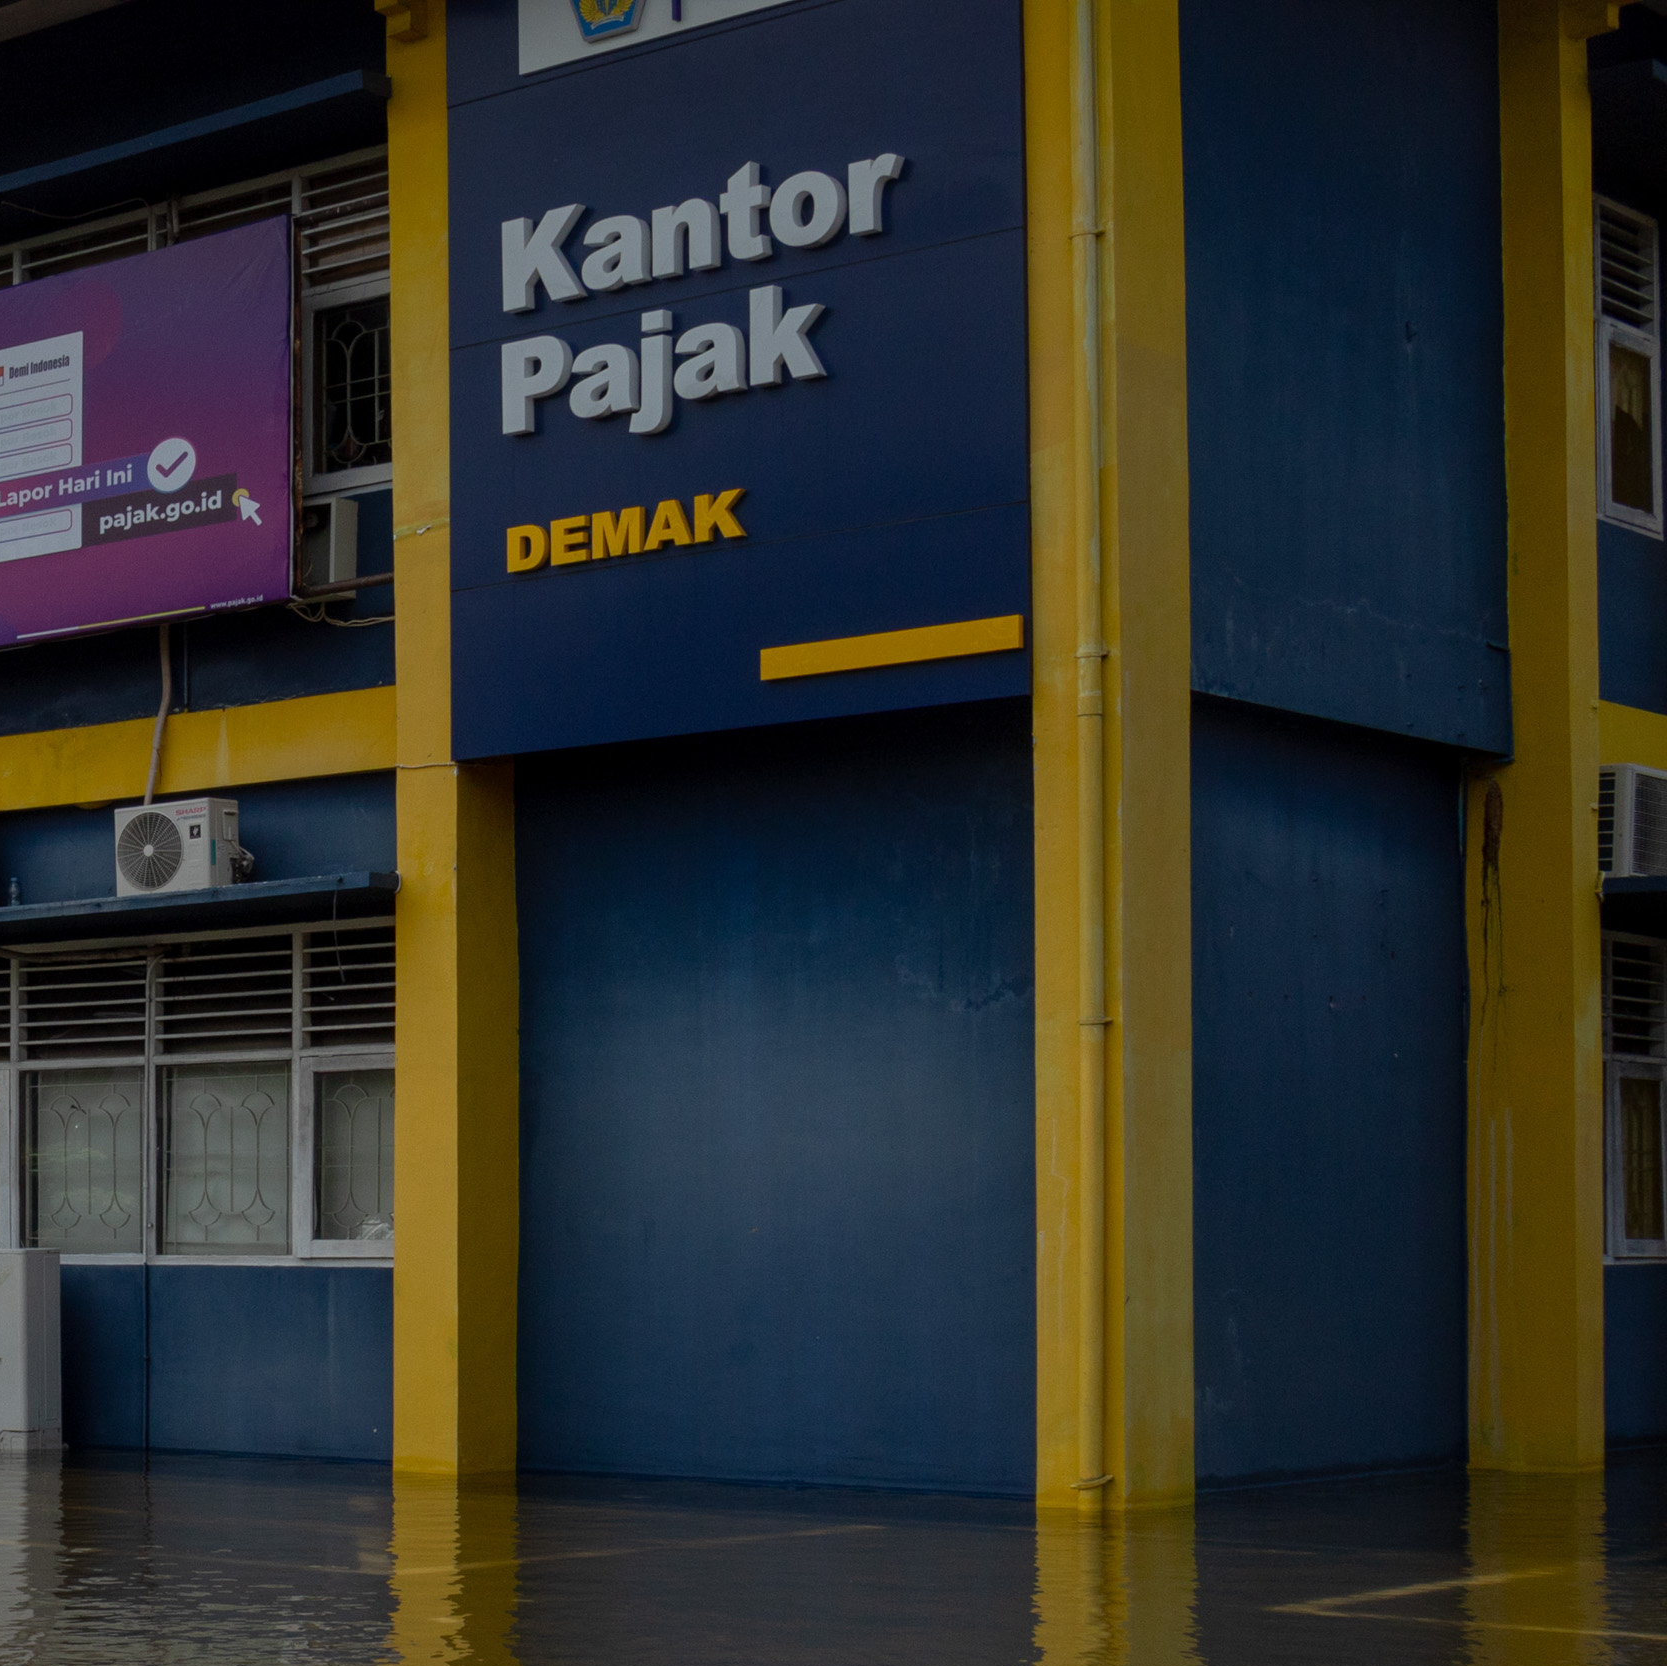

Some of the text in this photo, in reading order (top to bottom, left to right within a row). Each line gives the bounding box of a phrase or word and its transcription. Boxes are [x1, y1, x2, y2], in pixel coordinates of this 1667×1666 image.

[501, 152, 905, 314] Kantor
[9, 354, 70, 380] Demi Indonesia
[501, 285, 828, 436] Pajak
[58, 470, 100, 496] Hari
[106, 463, 133, 487] Ini
[99, 490, 223, 534] pajak.go.id
[506, 488, 747, 573] DEMAK
[210, 594, 263, 609] www.pajak.go.id
